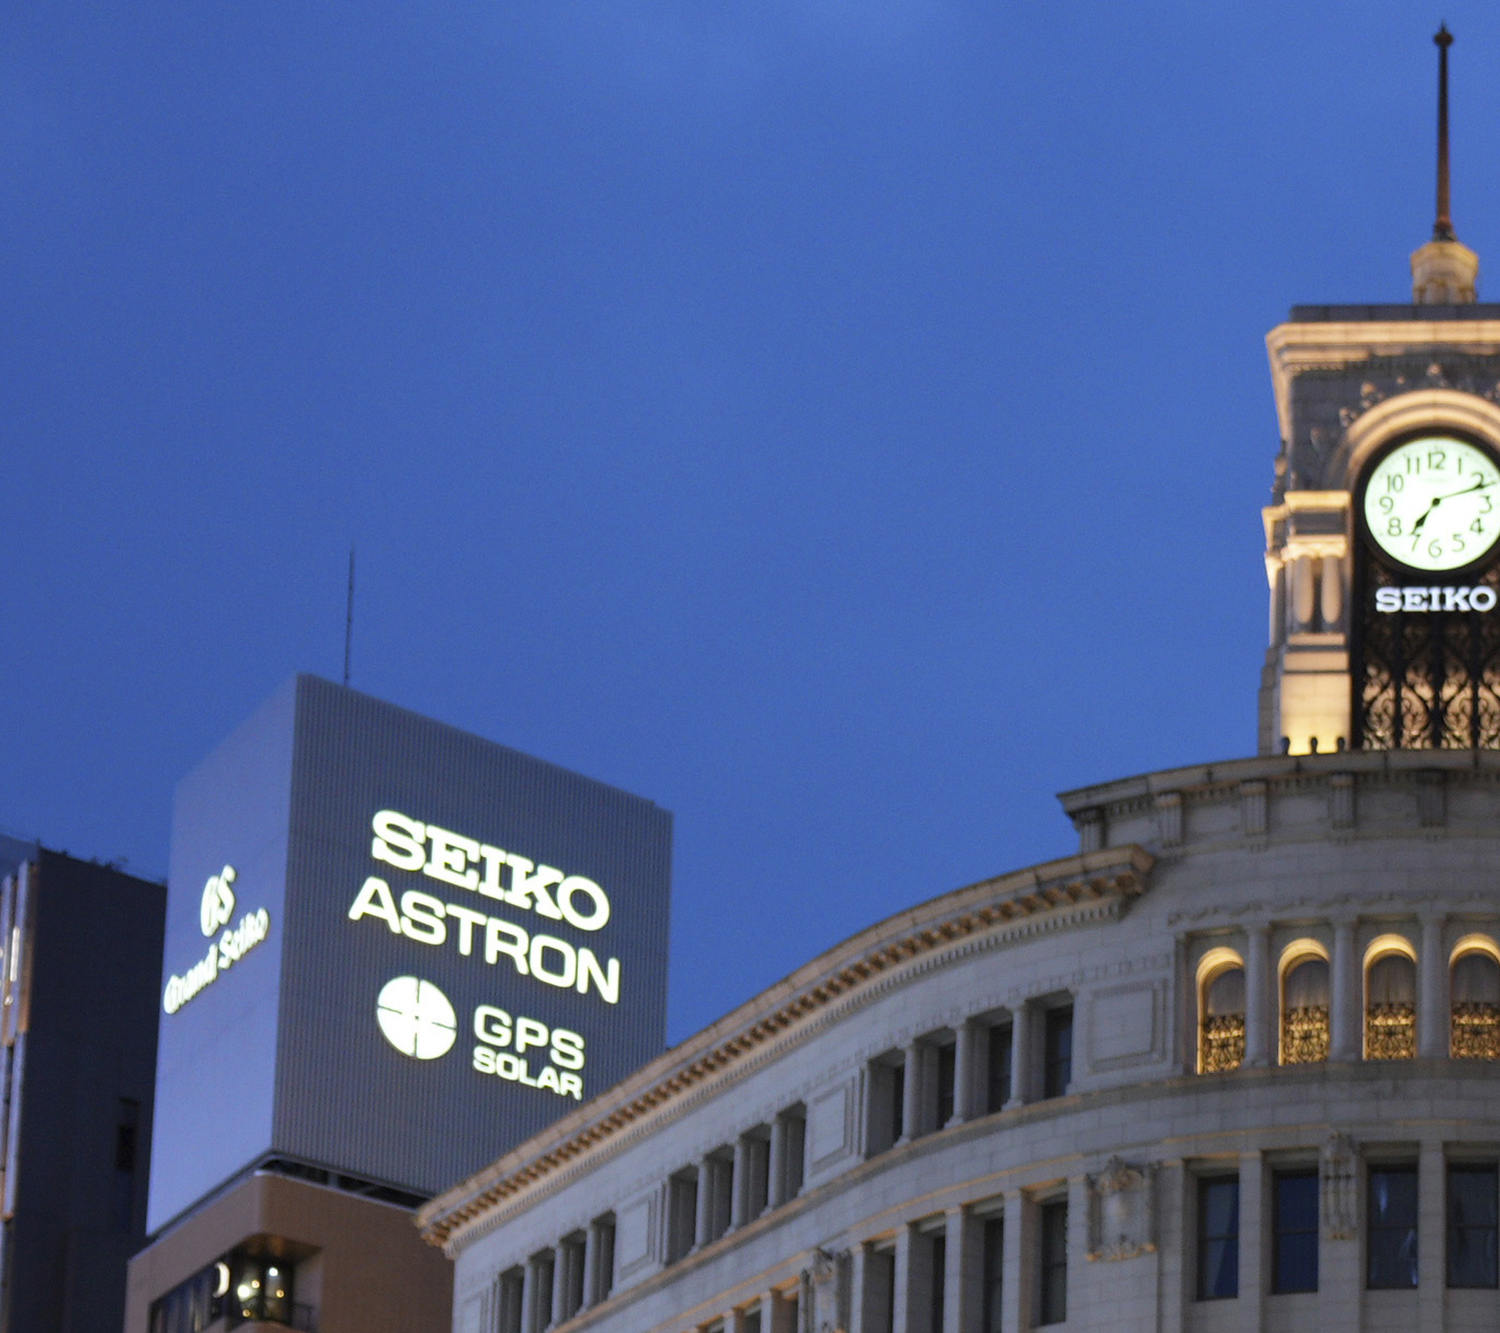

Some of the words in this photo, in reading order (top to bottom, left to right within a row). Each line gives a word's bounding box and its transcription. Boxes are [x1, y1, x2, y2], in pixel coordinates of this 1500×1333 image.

[1406, 457, 1421, 475] 11
[1427, 451, 1446, 470] 12
[1457, 457, 1462, 475] 1
[1386, 473, 1404, 493] 10
[1470, 472, 1485, 489] 2
[1378, 495, 1394, 515] 9
[1478, 495, 1493, 514] 3
[1387, 516, 1403, 537] 8
[1470, 517, 1485, 535] 4
[1409, 532, 1422, 553] 7
[1427, 538, 1443, 559] 6
[1451, 533, 1465, 553] 5
[1375, 586, 1498, 612] SEIKO
[371, 808, 611, 933] SEIKO
[347, 876, 621, 1005] ASTRON
[472, 1004, 587, 1071] GPS
[471, 1043, 587, 1102] SOLAR
